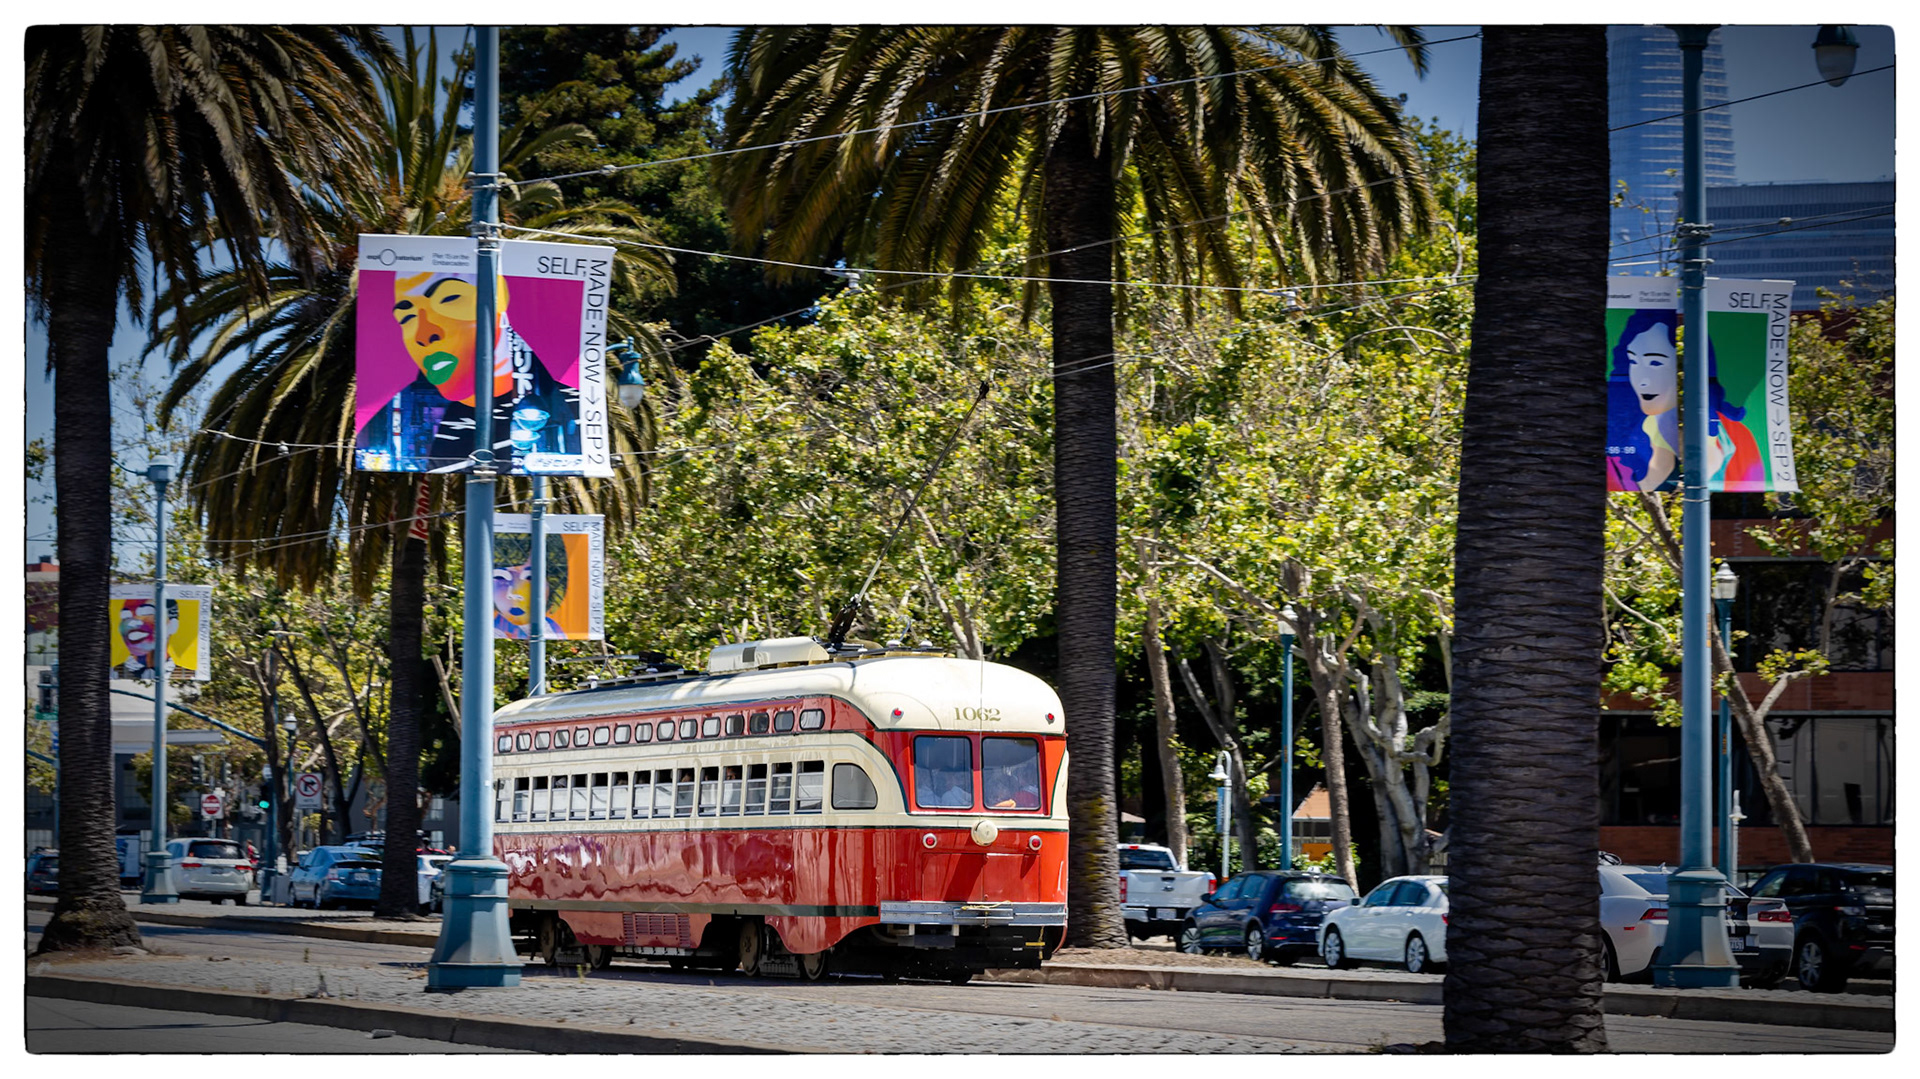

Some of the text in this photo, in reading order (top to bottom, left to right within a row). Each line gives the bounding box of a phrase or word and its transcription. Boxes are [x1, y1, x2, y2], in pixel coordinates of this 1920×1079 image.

[584, 331, 602, 384] NOW
[1769, 359, 1785, 407] NOW
[585, 409, 604, 450] SEP
[587, 453, 605, 465] 2
[1772, 430, 1790, 468] SEP
[1776, 471, 1792, 482] 2
[591, 560, 601, 588] NOW
[592, 601, 602, 626] SEP
[591, 625, 601, 634] 2
[953, 706, 1002, 722] 1062
